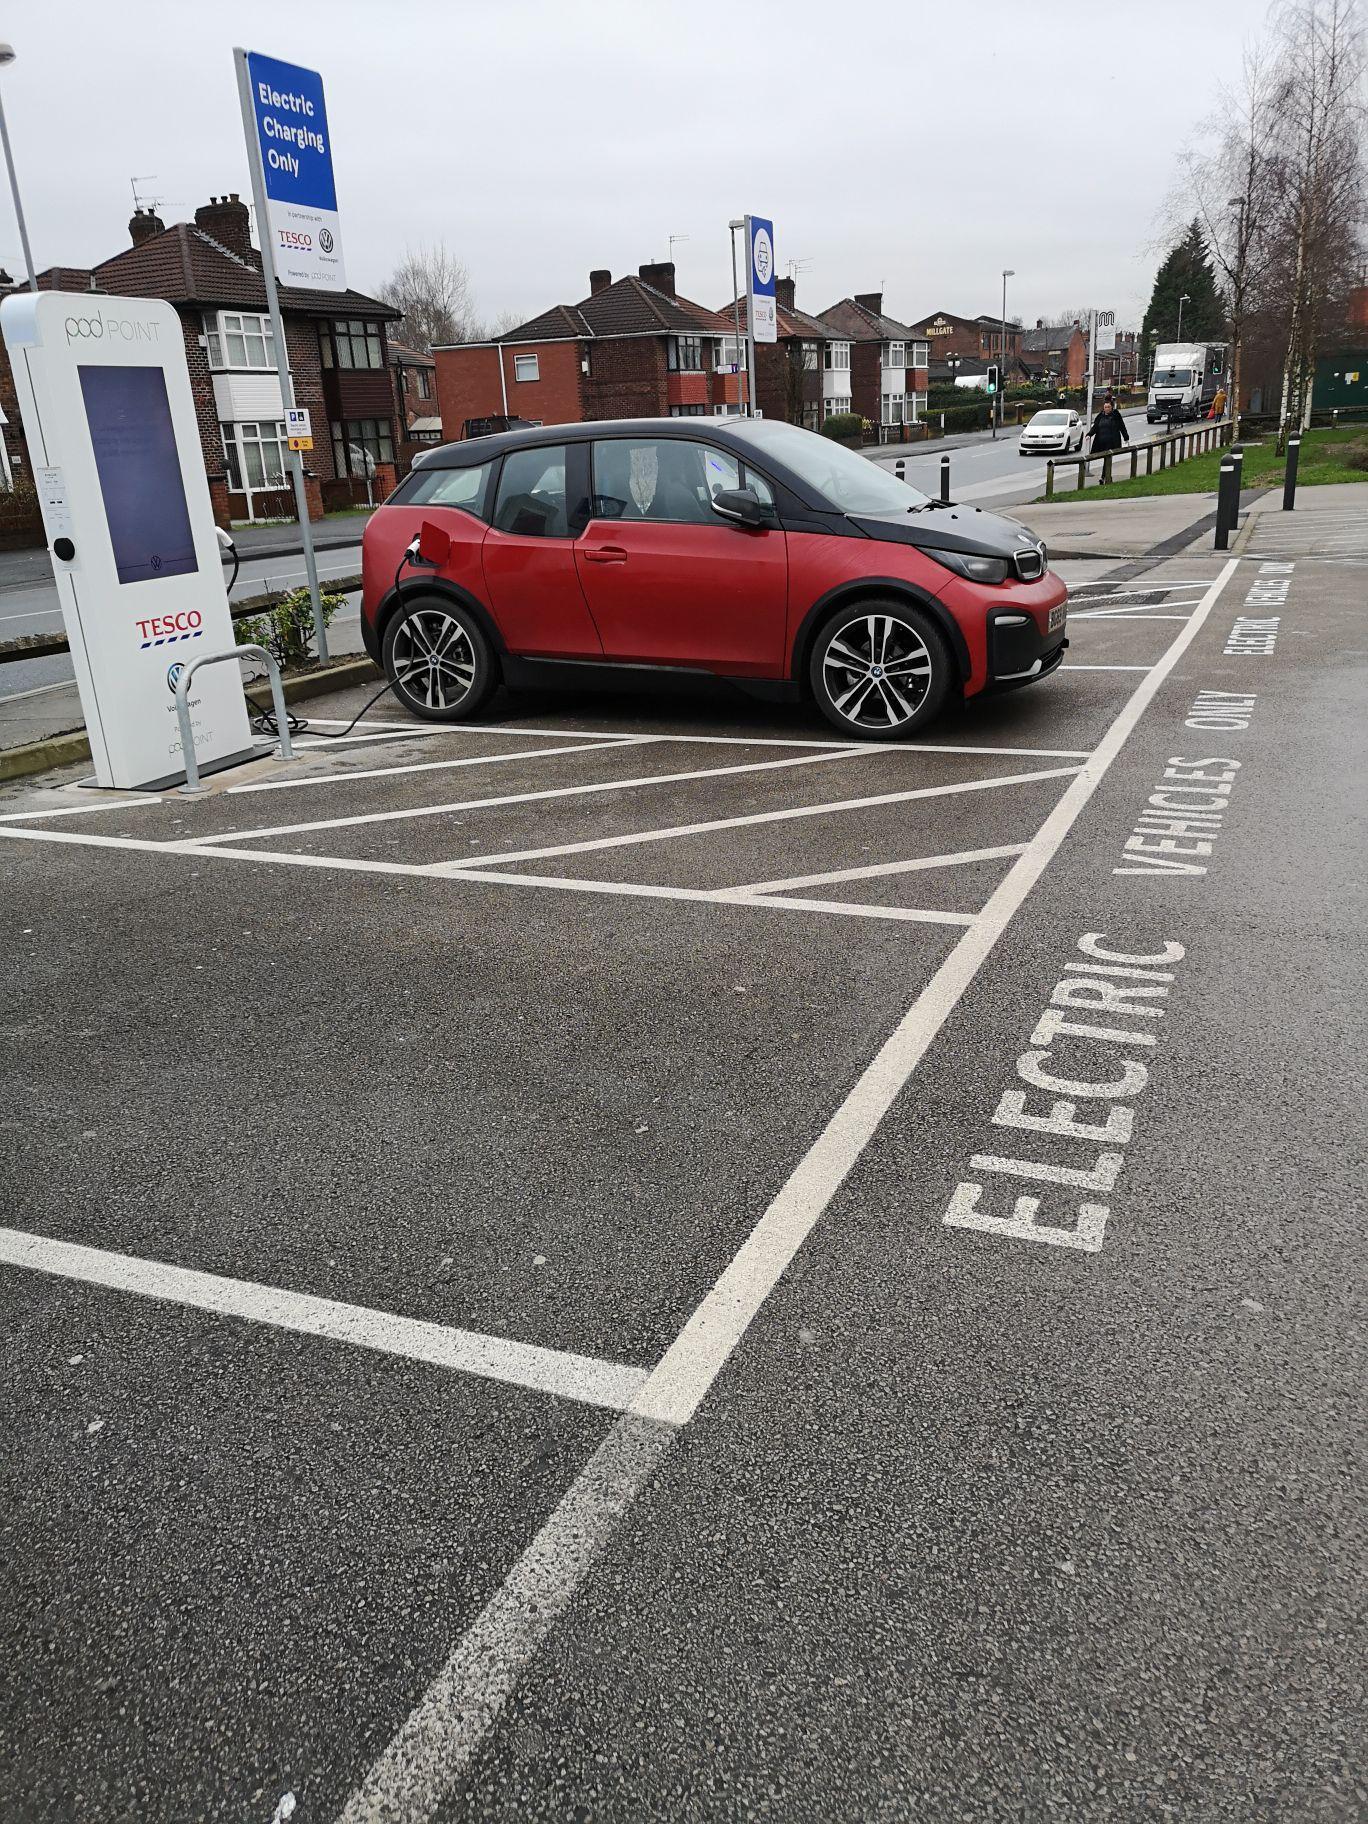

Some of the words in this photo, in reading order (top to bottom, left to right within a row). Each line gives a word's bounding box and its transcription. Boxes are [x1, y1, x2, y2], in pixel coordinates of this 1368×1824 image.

[258, 82, 314, 117] Electric
[263, 116, 325, 154] Charging
[267, 148, 299, 178] Only
[291, 212, 314, 222] partnership
[314, 215, 323, 223] with
[278, 230, 312, 246] TESCO
[64, 309, 104, 347] pod
[106, 320, 160, 342] POINT
[926, 326, 954, 336] MILLGATE
[136, 610, 202, 639] TESCO
[1223, 616, 1281, 655] ELECTRIC
[942, 932, 1186, 1252] ELECTRIC
[1112, 756, 1242, 876] VEHICLES
[1184, 690, 1258, 731] ONLY
